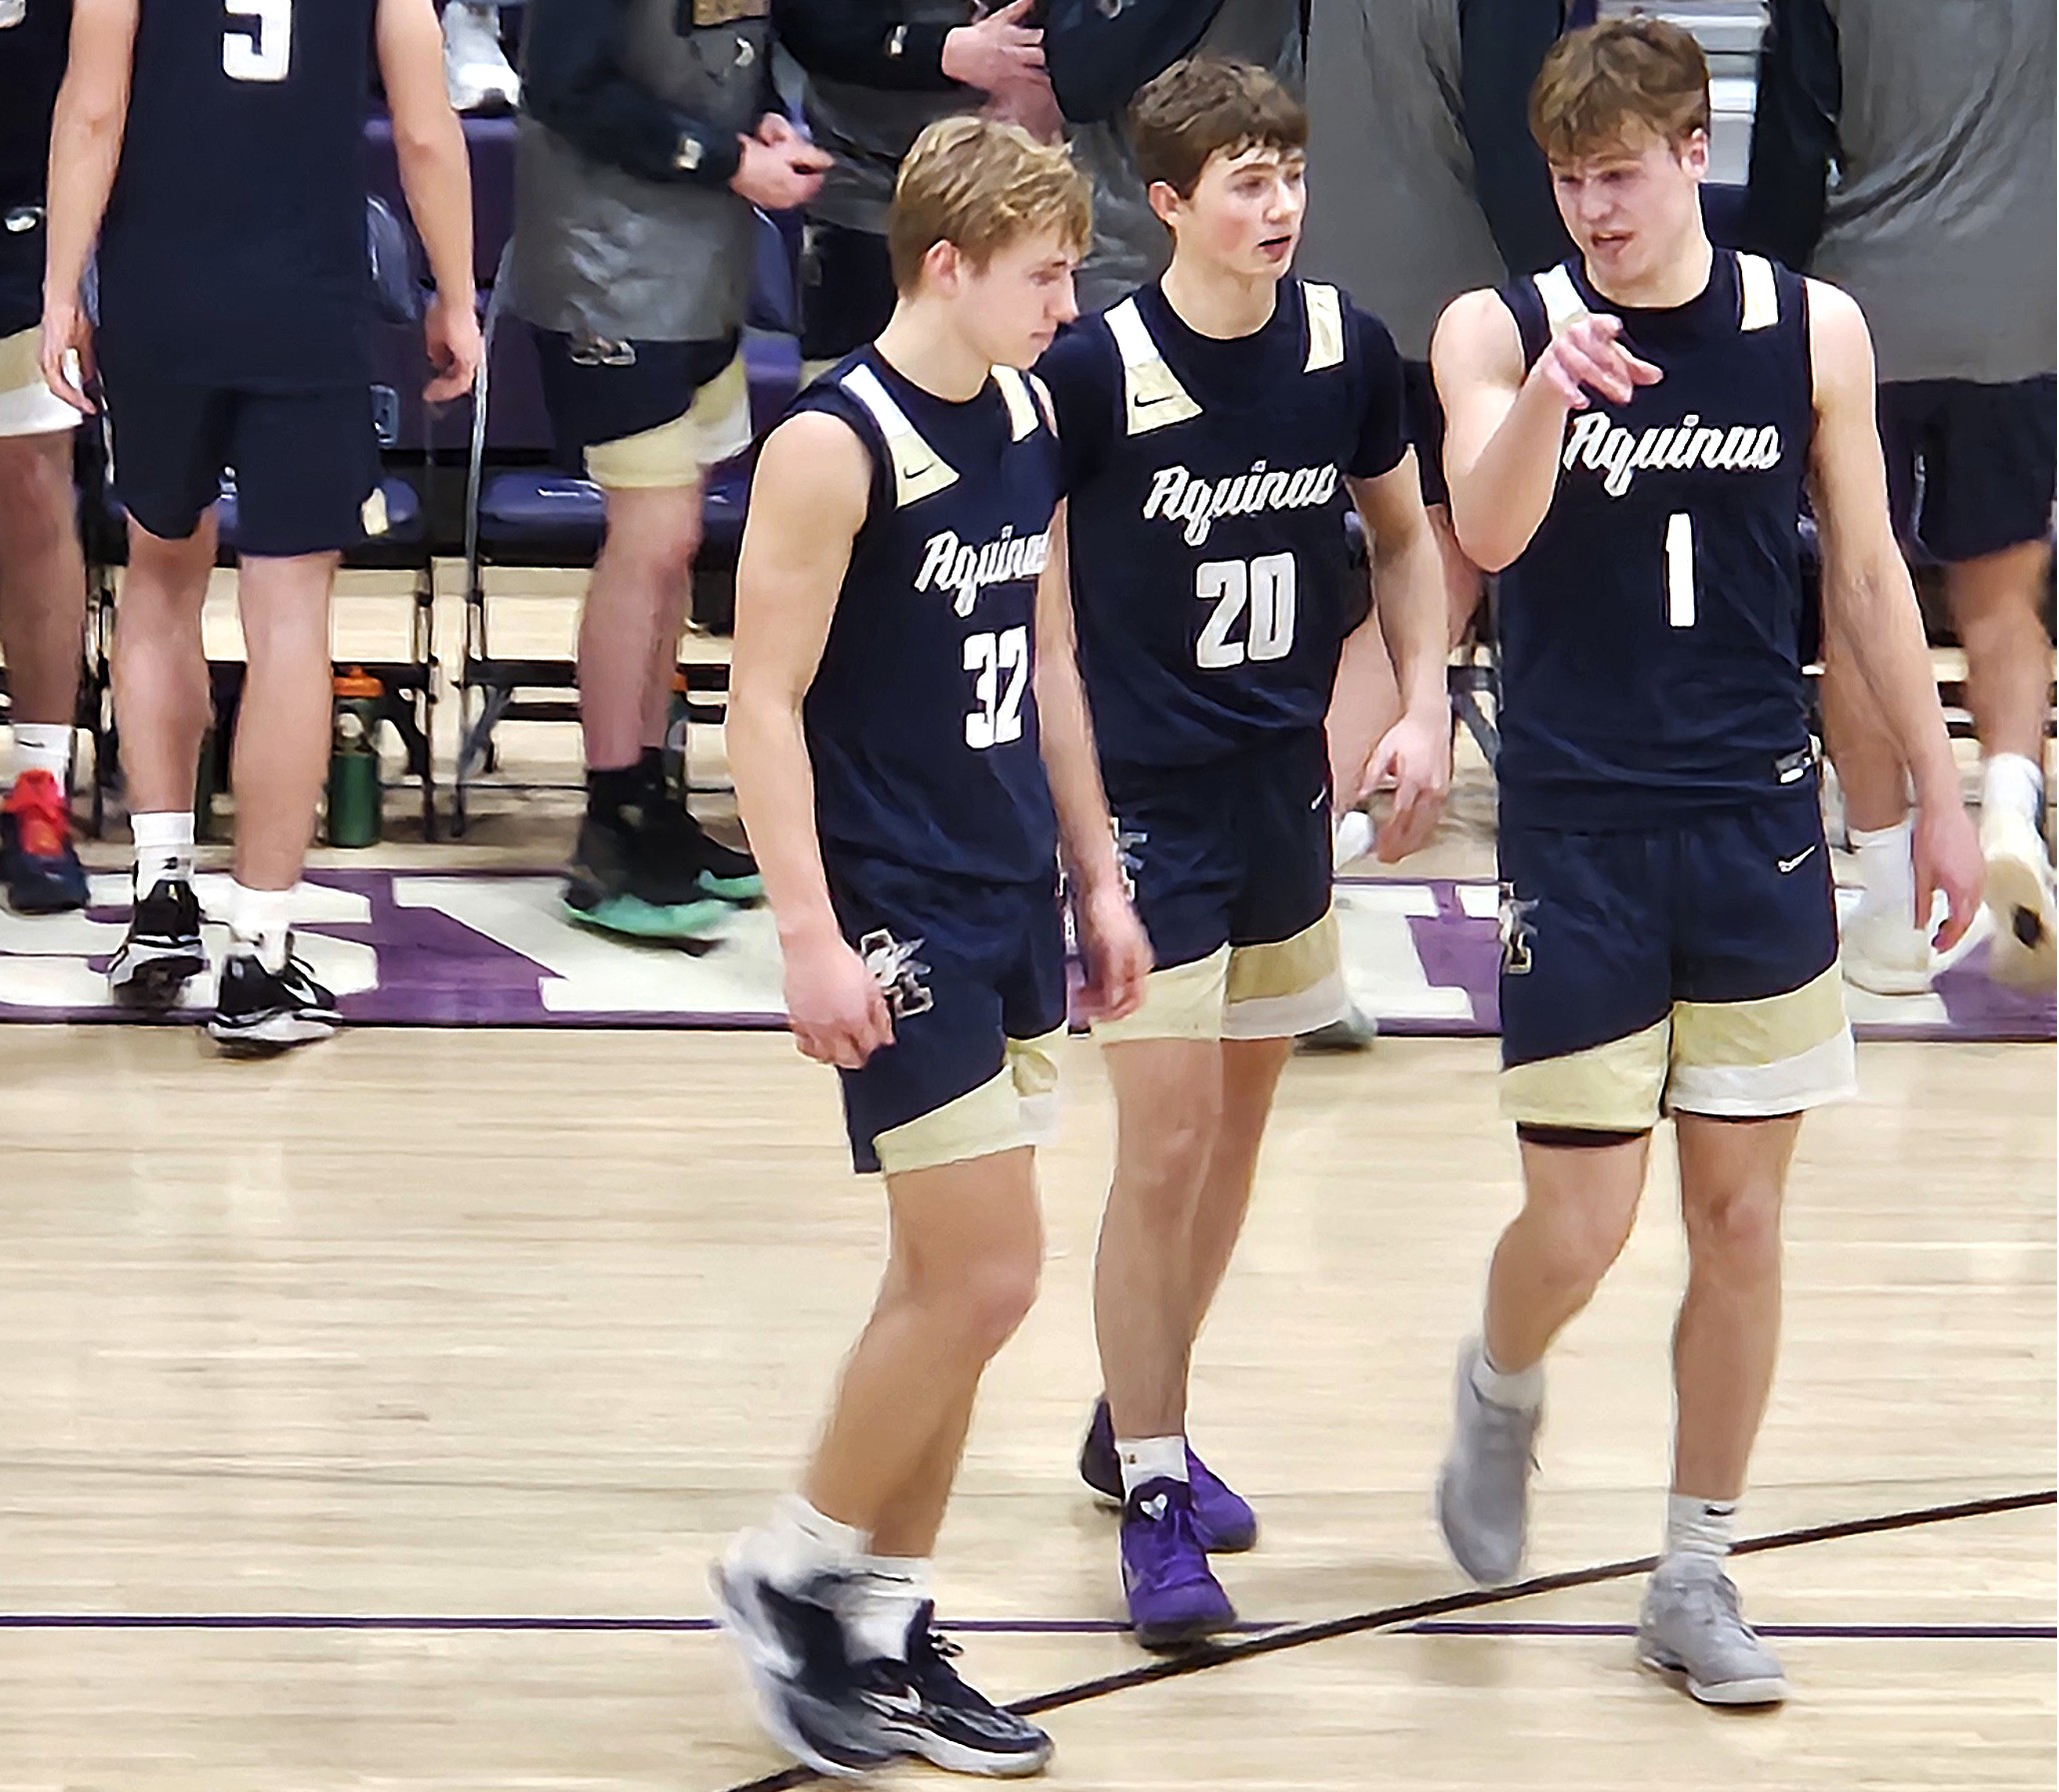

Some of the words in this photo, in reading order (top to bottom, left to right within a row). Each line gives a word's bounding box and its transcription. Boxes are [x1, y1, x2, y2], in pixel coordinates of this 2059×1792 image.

[1142, 460, 1338, 547] Aquinas
[1562, 411, 1782, 498] Aquinas
[1196, 552, 1296, 669] 20
[1665, 512, 1696, 628] 1
[963, 625, 1029, 750] 32
